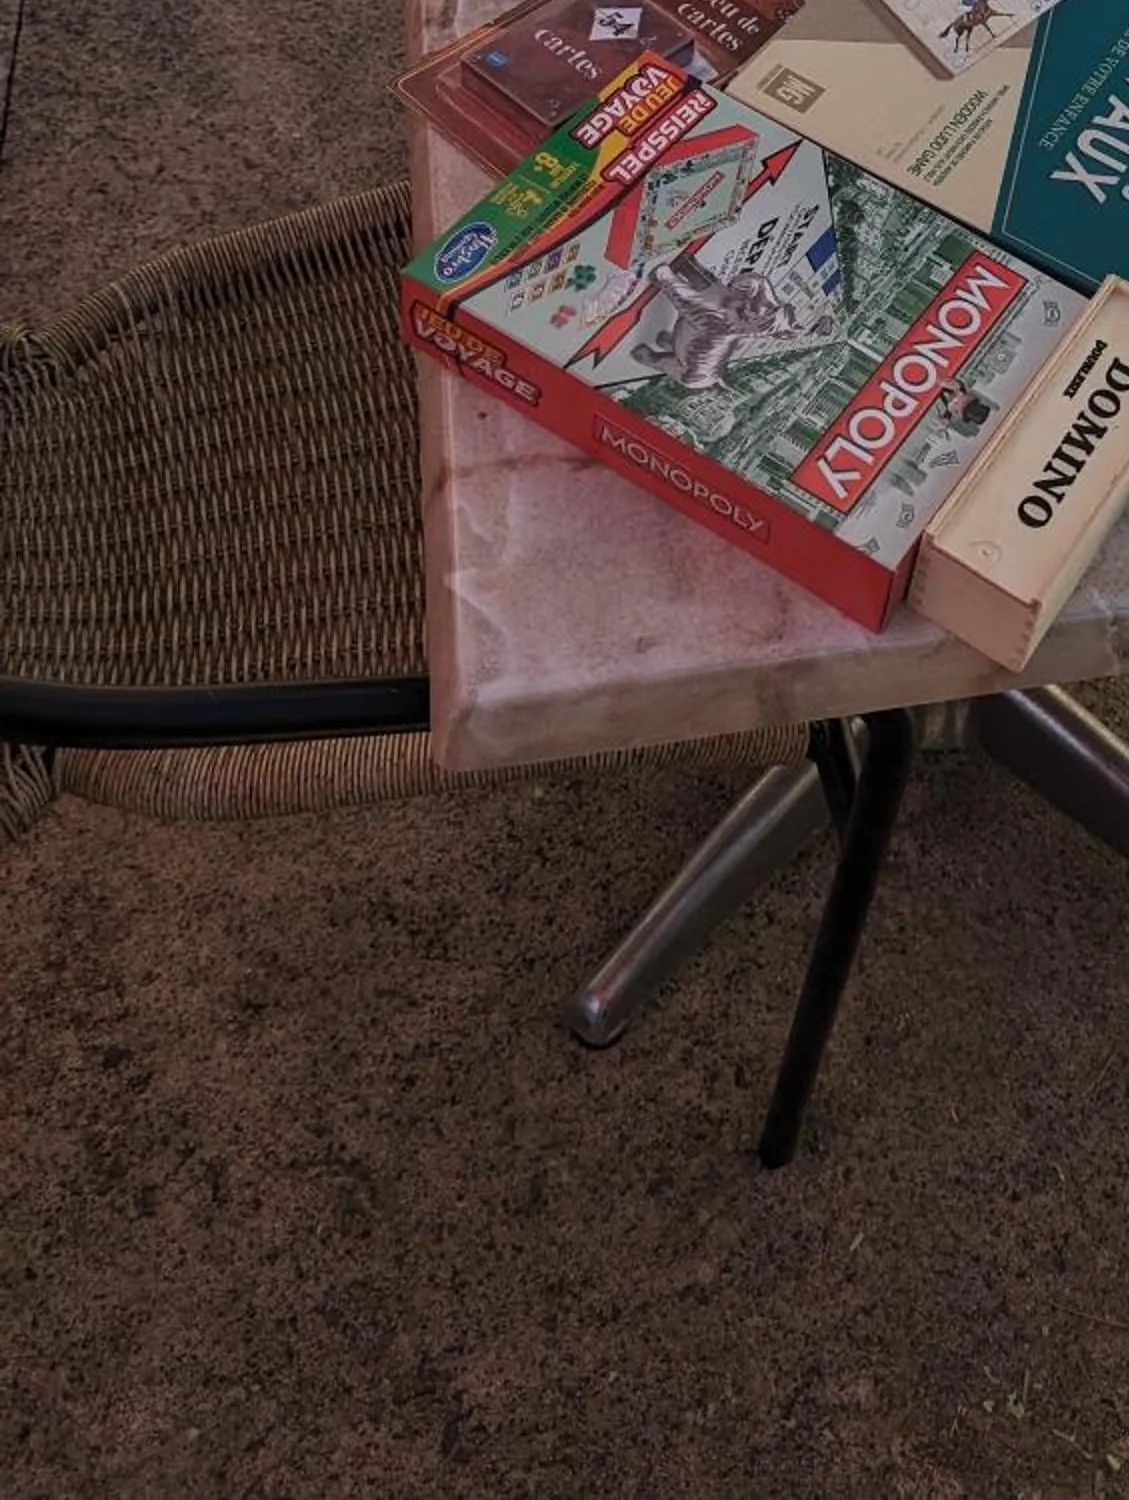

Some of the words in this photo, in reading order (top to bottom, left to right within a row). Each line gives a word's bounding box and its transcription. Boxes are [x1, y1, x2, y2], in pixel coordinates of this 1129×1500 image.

[597, 11, 634, 39] 54
[677, 2, 744, 54] cartes
[736, 14, 761, 35] de
[533, 27, 603, 82] cartes
[1081, 56, 1120, 95] VOTRE
[575, 65, 669, 147] VOYAGE
[646, 76, 684, 111] JEU
[949, 87, 988, 130] WOODEN
[621, 106, 648, 136] DE
[927, 120, 958, 155] LUDO
[1038, 92, 1089, 150] ENFANCE
[905, 146, 936, 179] GAME
[416, 319, 539, 404] VOYAGE
[815, 263, 1010, 500] MONOPOLY
[598, 426, 766, 534] MONOPOLY
